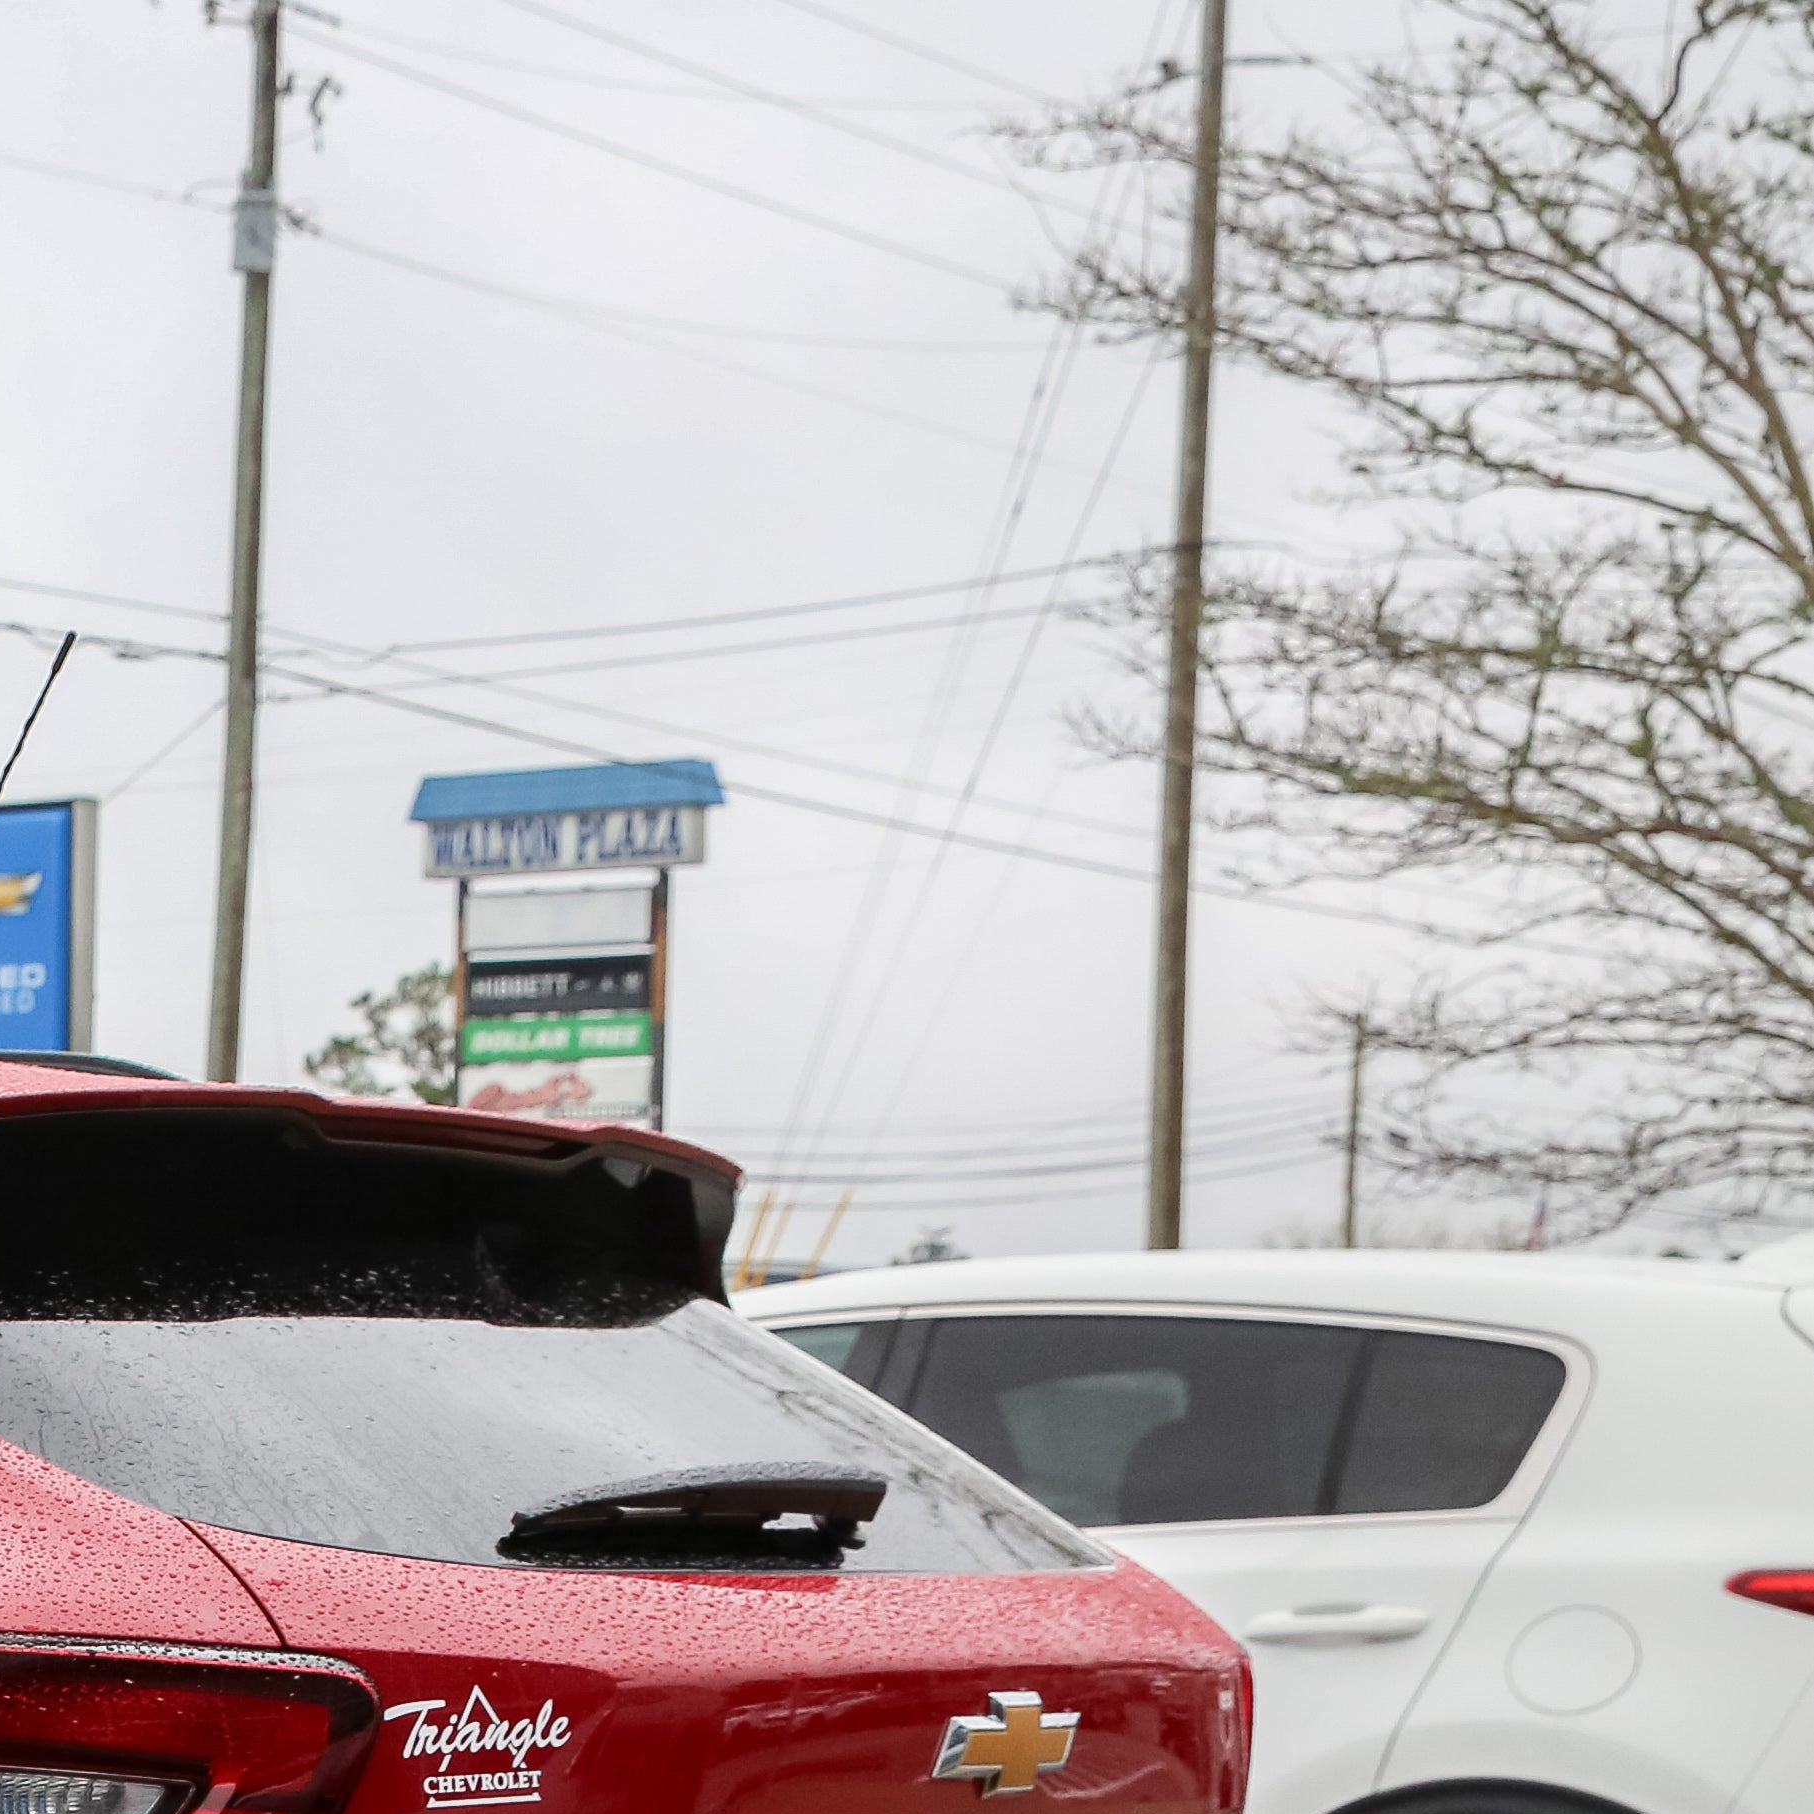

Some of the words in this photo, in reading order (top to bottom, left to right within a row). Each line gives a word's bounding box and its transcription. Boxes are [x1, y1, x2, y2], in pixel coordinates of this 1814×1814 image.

[432, 815, 557, 867] WALTON
[576, 811, 681, 861] PLAZA
[470, 1027, 572, 1054] DOLLAR
[578, 1023, 642, 1049] TREE
[383, 1698, 572, 1768] Triangle
[423, 1770, 542, 1795] CHEVROLET
